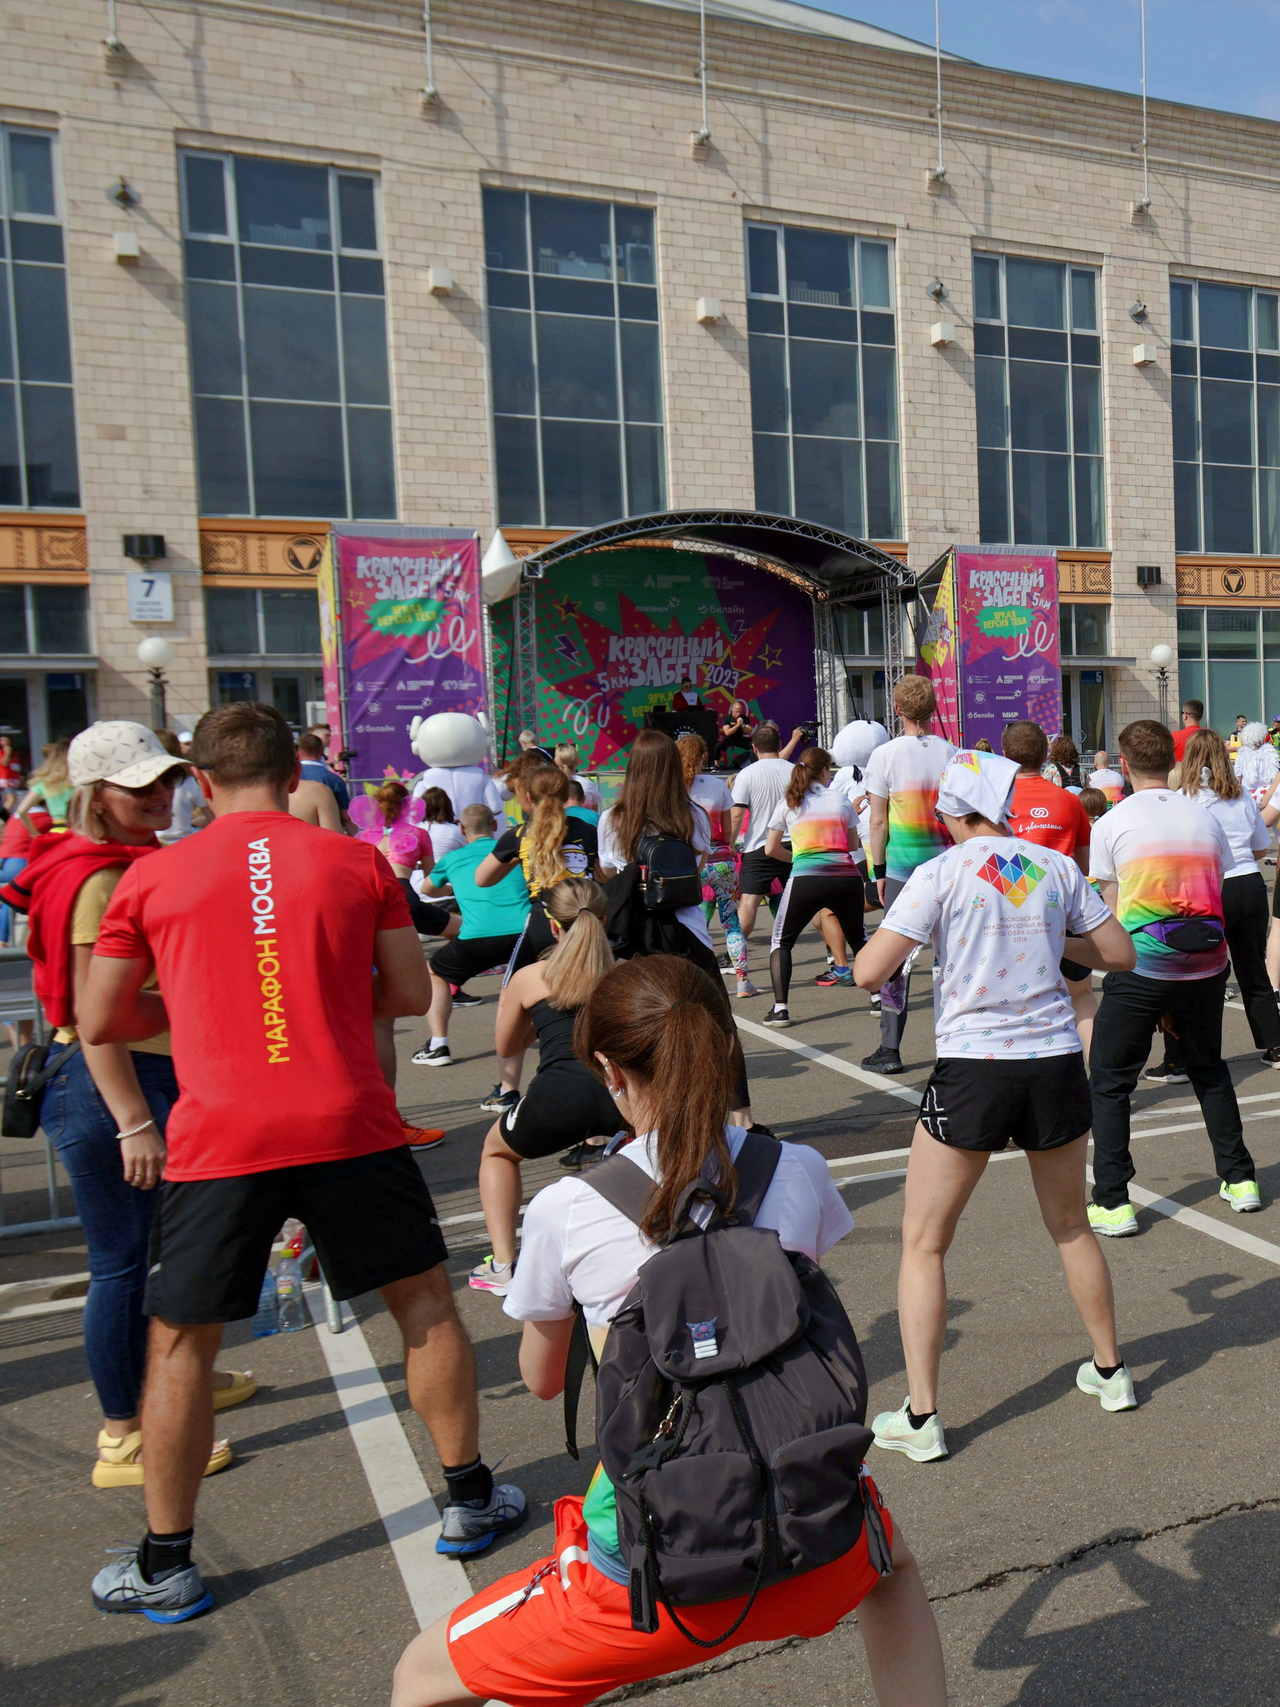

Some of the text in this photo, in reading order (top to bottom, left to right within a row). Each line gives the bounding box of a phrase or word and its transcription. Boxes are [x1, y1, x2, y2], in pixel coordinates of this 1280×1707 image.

[356, 553, 462, 579] КРАСОЧНЫЙ
[141, 579, 155, 597] 7
[374, 574, 440, 600] ЗАБЕГ
[969, 568, 1045, 589] КРАСОЧНЫЙ
[444, 582, 456, 597] 5
[981, 585, 1032, 608] ЗАБЕГ
[1031, 592, 1041, 606] 5
[709, 604, 745, 614] билайн
[993, 610, 1016, 620] ЯРКАЯ
[983, 616, 1027, 629] ВЕРСИЯ ТЕБЯ
[608, 630, 724, 662] КРАСОЧНЫЙ
[243, 673, 253, 688] 2
[596, 672, 610, 692] 5
[628, 656, 705, 688] ЗАБЕГ
[704, 664, 740, 689] 2023
[1096, 672, 1102, 683] 5
[365, 724, 395, 732] билайн
[248, 837, 276, 934] МОСКВА
[255, 939, 290, 1064] МАРАФОН
